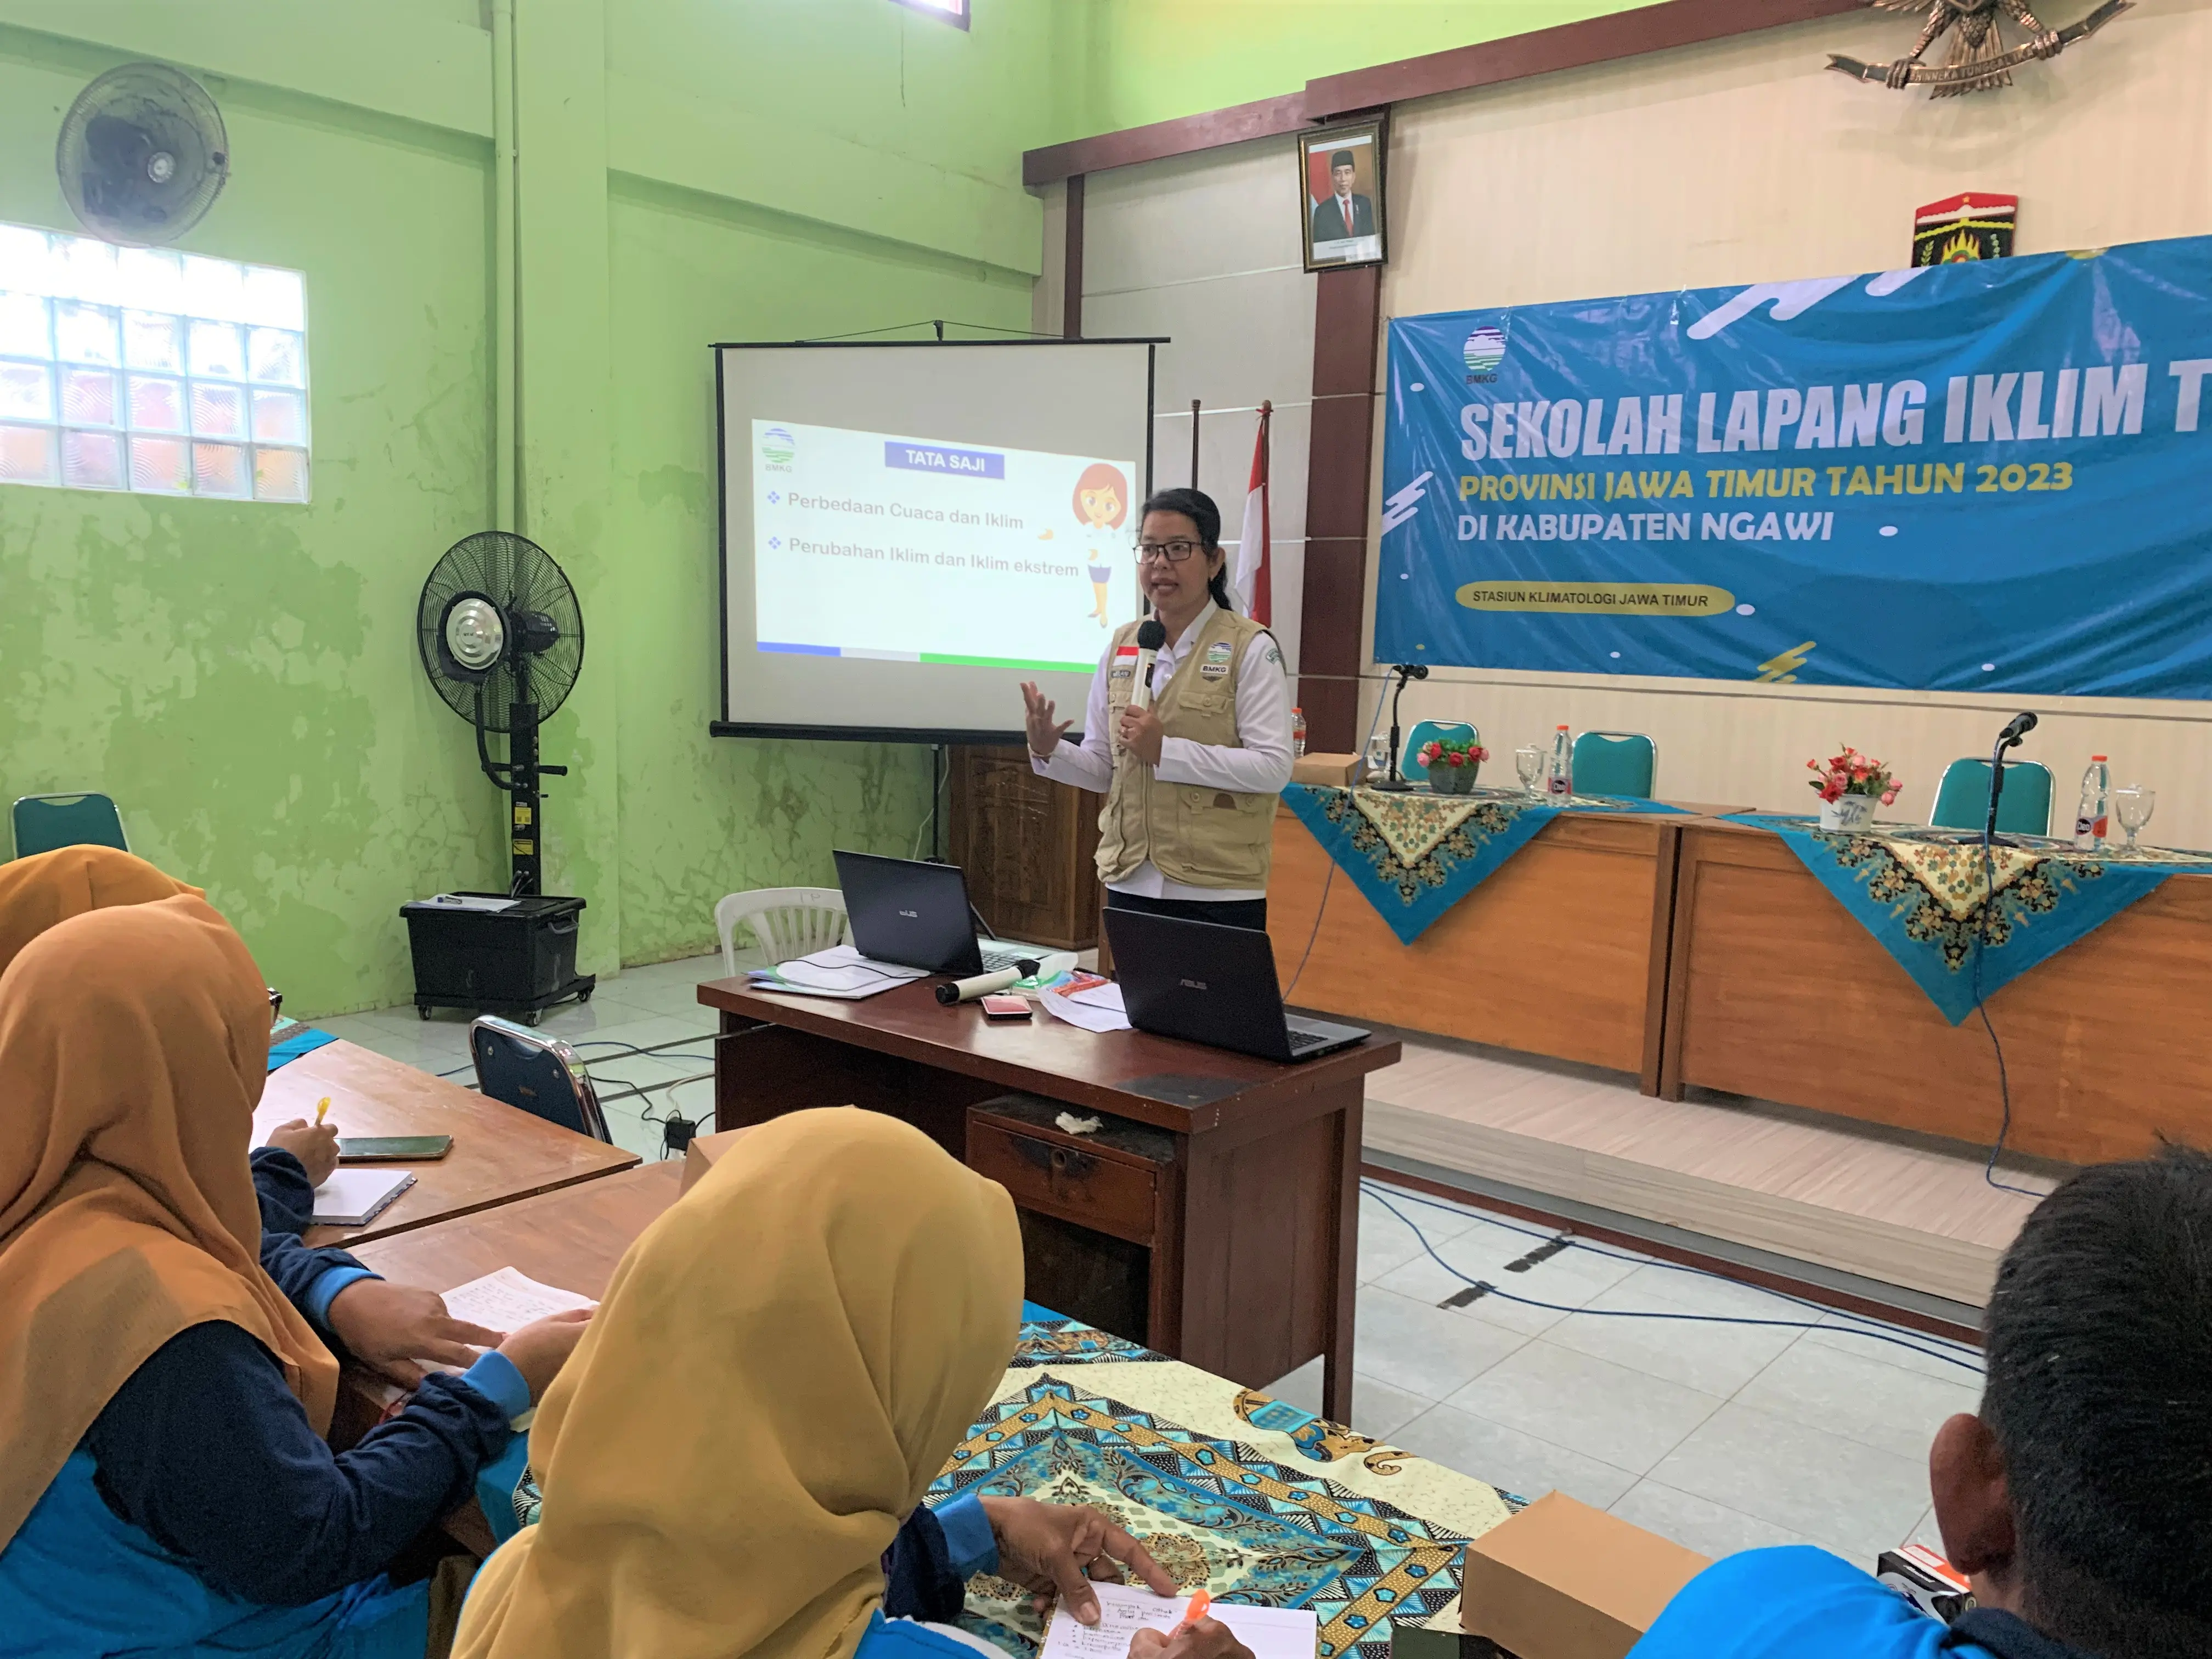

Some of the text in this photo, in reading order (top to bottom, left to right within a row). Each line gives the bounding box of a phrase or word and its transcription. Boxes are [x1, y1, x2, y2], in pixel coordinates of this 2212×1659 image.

[1466, 373, 1498, 385] BMKG
[1460, 394, 1683, 460] SEKOLAH
[1696, 380, 1927, 453] LAPANG
[1944, 363, 2148, 443] IKLIM
[906, 449, 985, 472] TATA SAJI
[1459, 461, 2073, 502] PROVINSI JAWA TIMUR TAHUN 2023
[788, 492, 1024, 529] Perbedaan Cuaca dan Iklim
[1457, 511, 1834, 541] DI KABUPATEN NGAWI
[789, 538, 1079, 577] Perubahan Iklim dan Iklim ekstrem
[1472, 591, 1708, 607] STASIUN KLIMATOLOGI JAWA TIMUR
